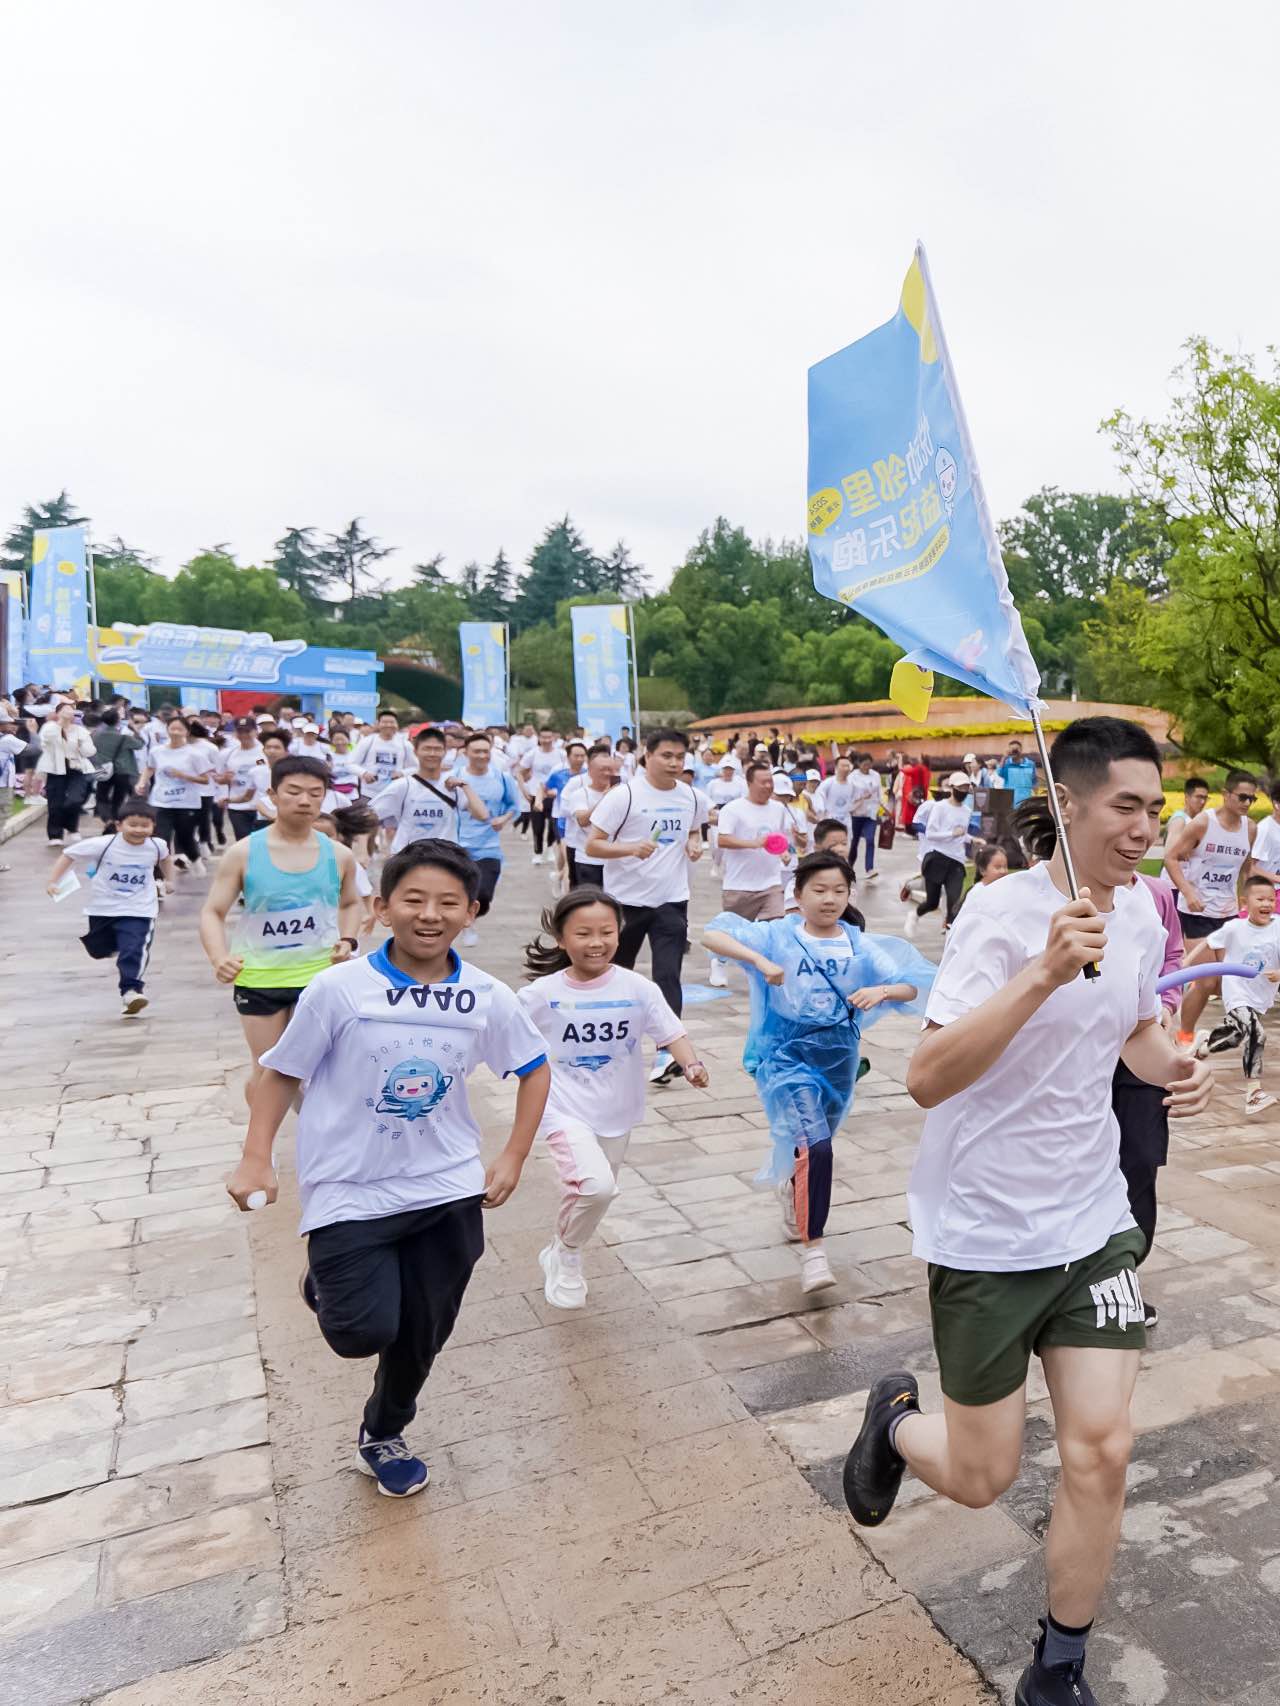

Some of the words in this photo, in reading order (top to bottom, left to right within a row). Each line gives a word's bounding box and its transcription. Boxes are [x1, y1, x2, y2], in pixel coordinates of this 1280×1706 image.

[413, 809, 443, 818] A488
[109, 872, 145, 884] A362
[262, 916, 315, 936] A424
[562, 1020, 629, 1043] A335
